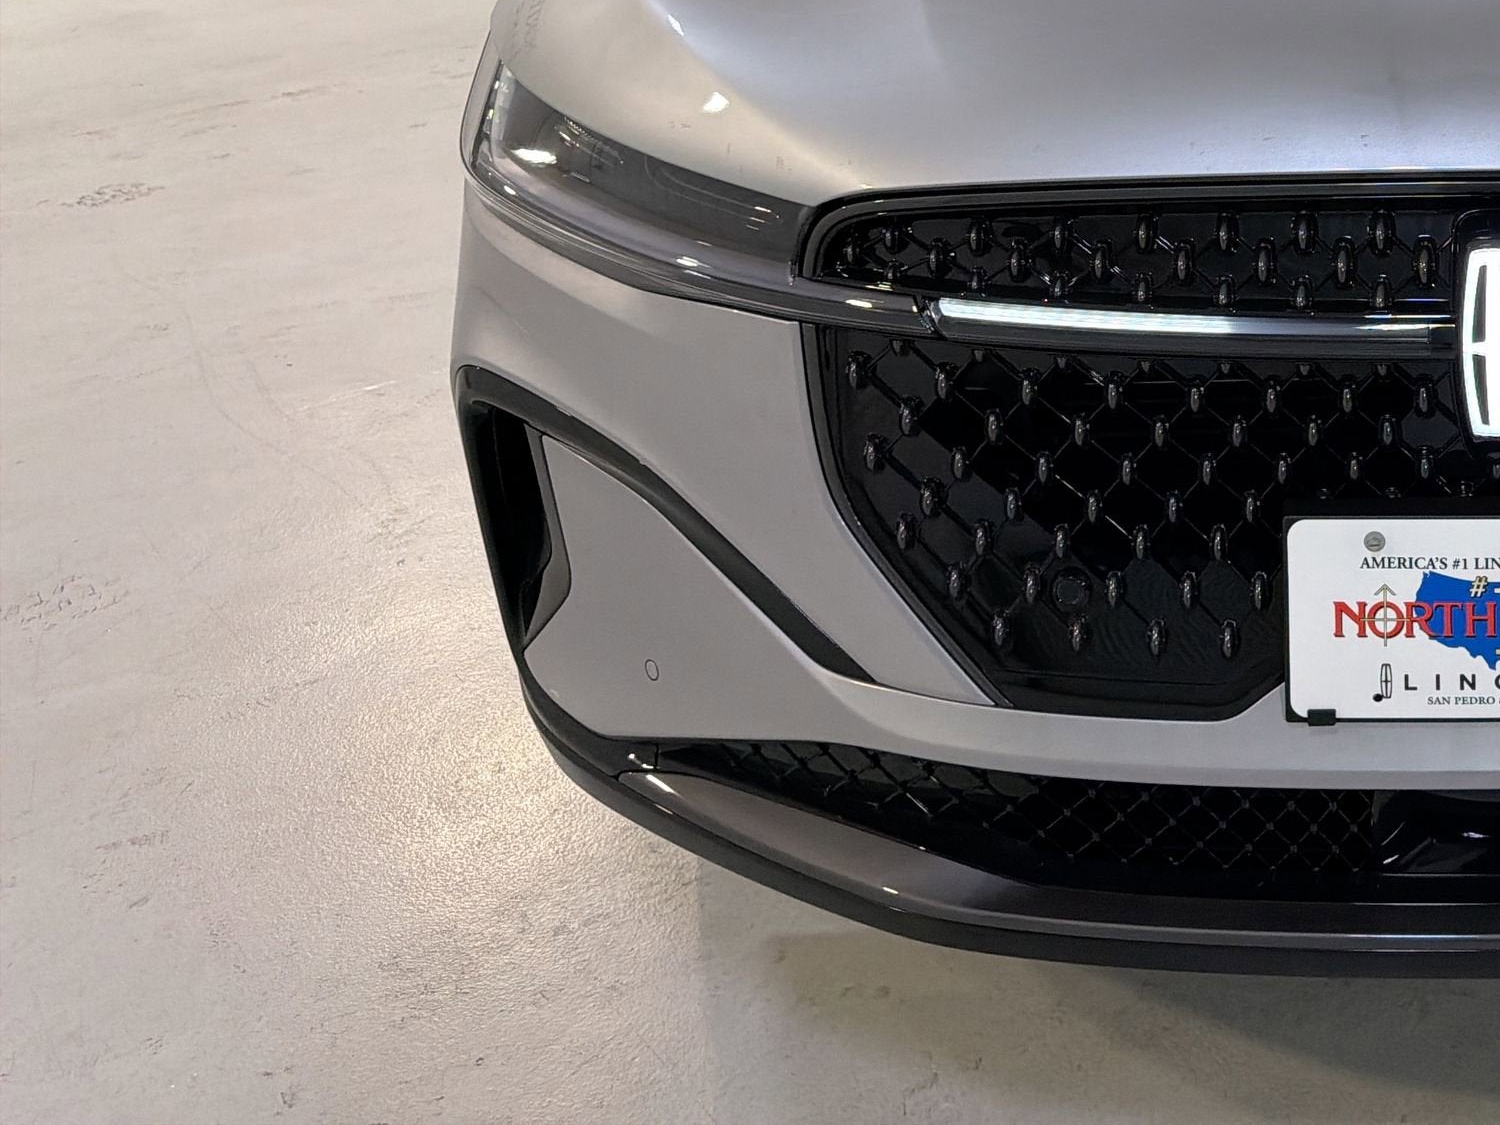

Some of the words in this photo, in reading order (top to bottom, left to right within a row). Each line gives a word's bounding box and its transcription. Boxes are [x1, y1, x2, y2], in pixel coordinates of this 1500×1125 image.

[1360, 555, 1448, 570] AMERICA'S
[1452, 556, 1468, 570] #1
[1332, 599, 1498, 638] NORTH
[1427, 696, 1451, 705] SAN
[1454, 696, 1495, 705] PEDRO
